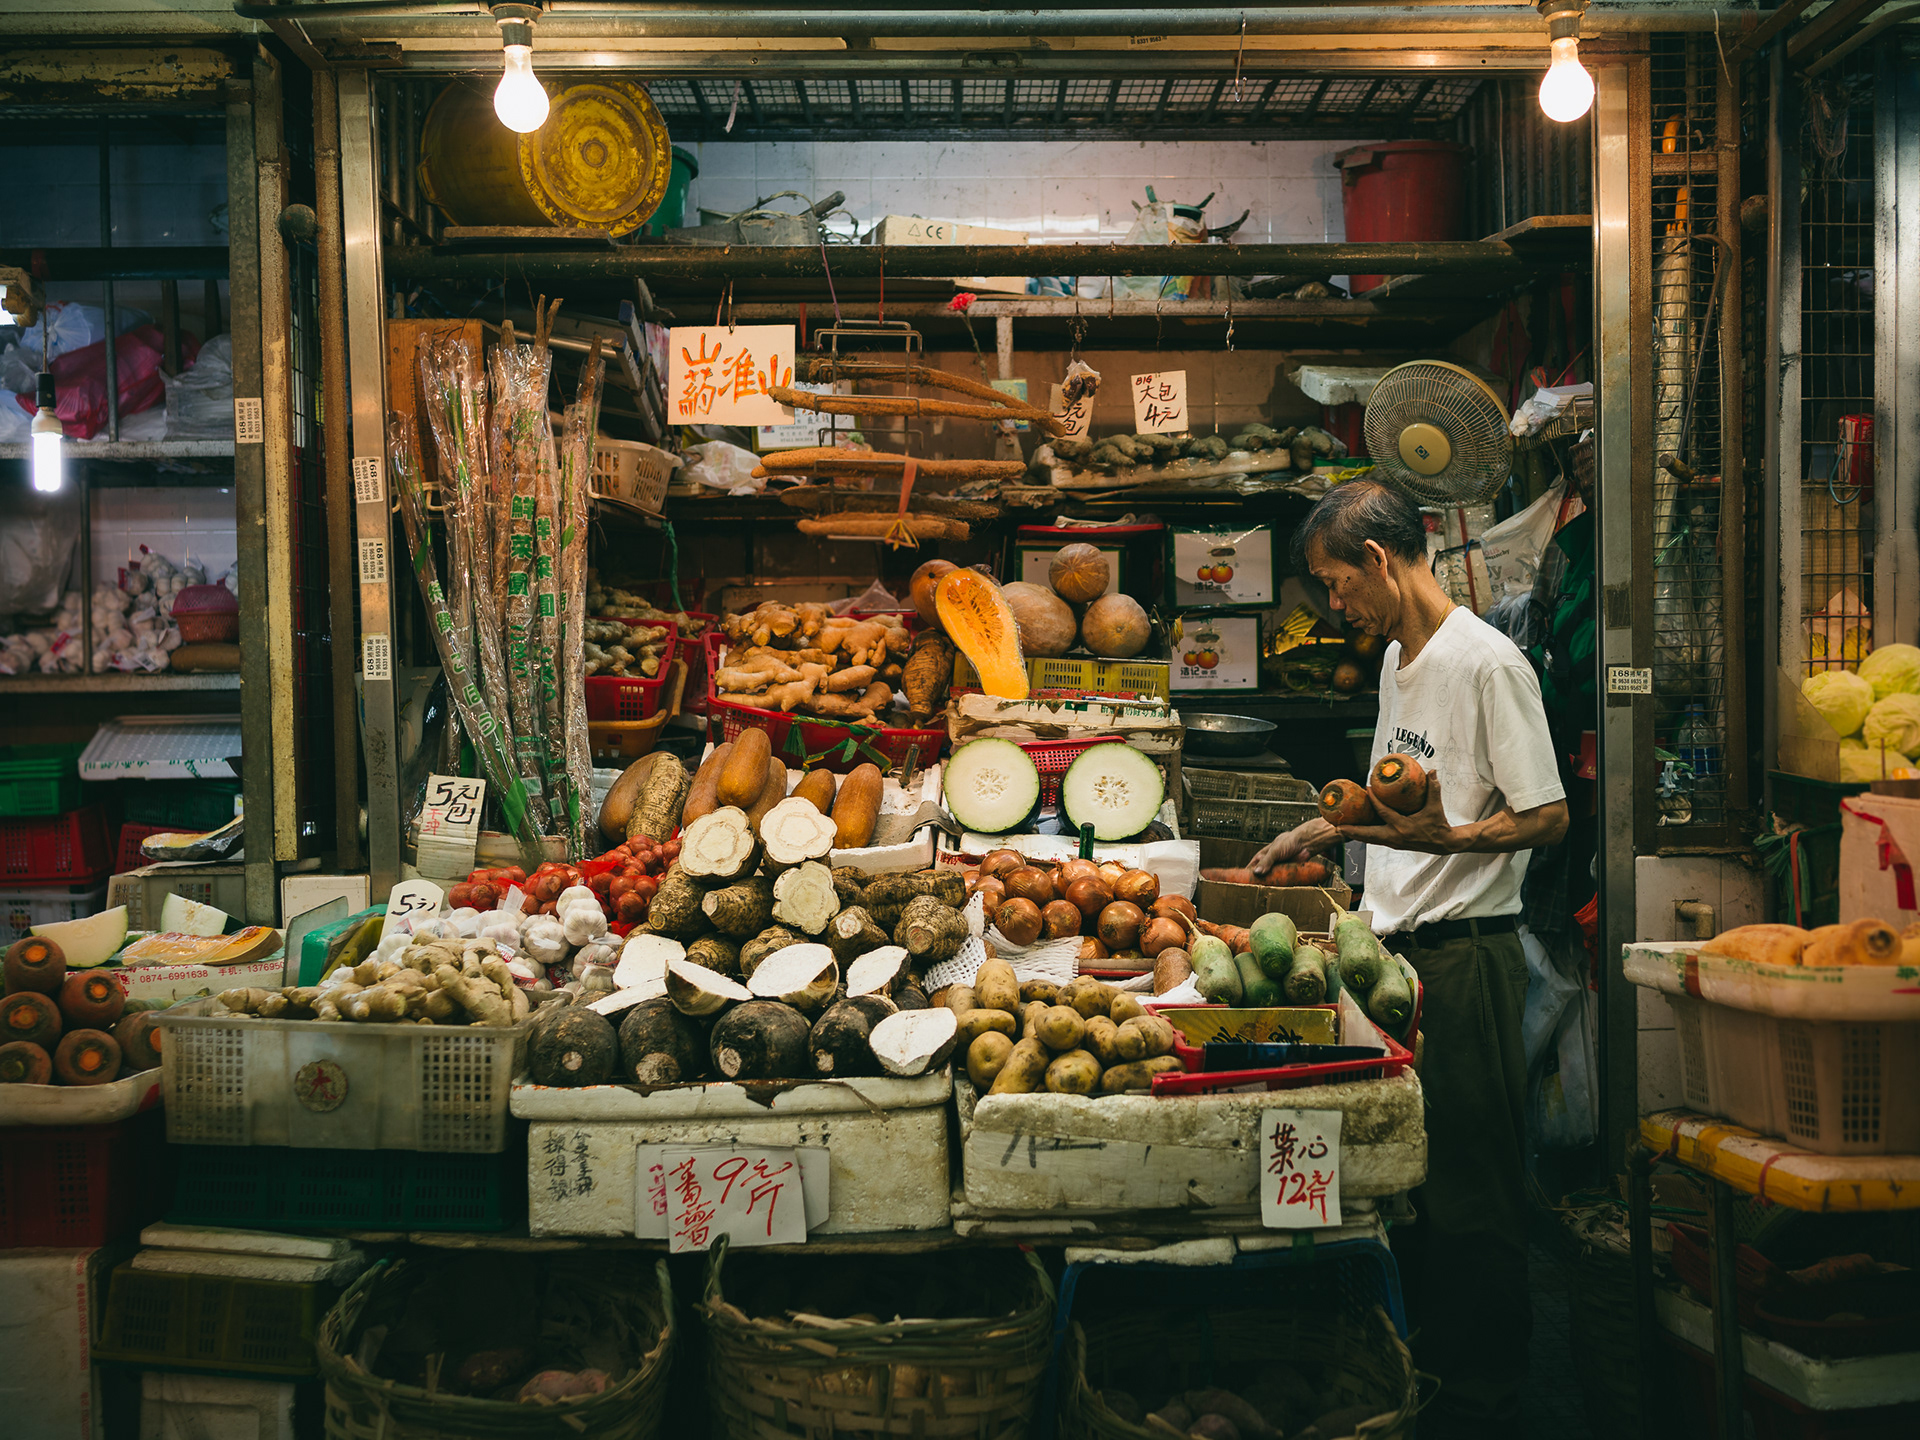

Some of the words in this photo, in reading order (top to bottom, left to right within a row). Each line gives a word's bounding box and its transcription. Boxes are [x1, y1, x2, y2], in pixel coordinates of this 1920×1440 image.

[926, 225, 943, 240] CE
[1139, 382, 1177, 404] 大包
[1144, 403, 1181, 428] 4元
[1395, 727, 1436, 759] LEGEND
[139, 969, 209, 984] 0874-6991638
